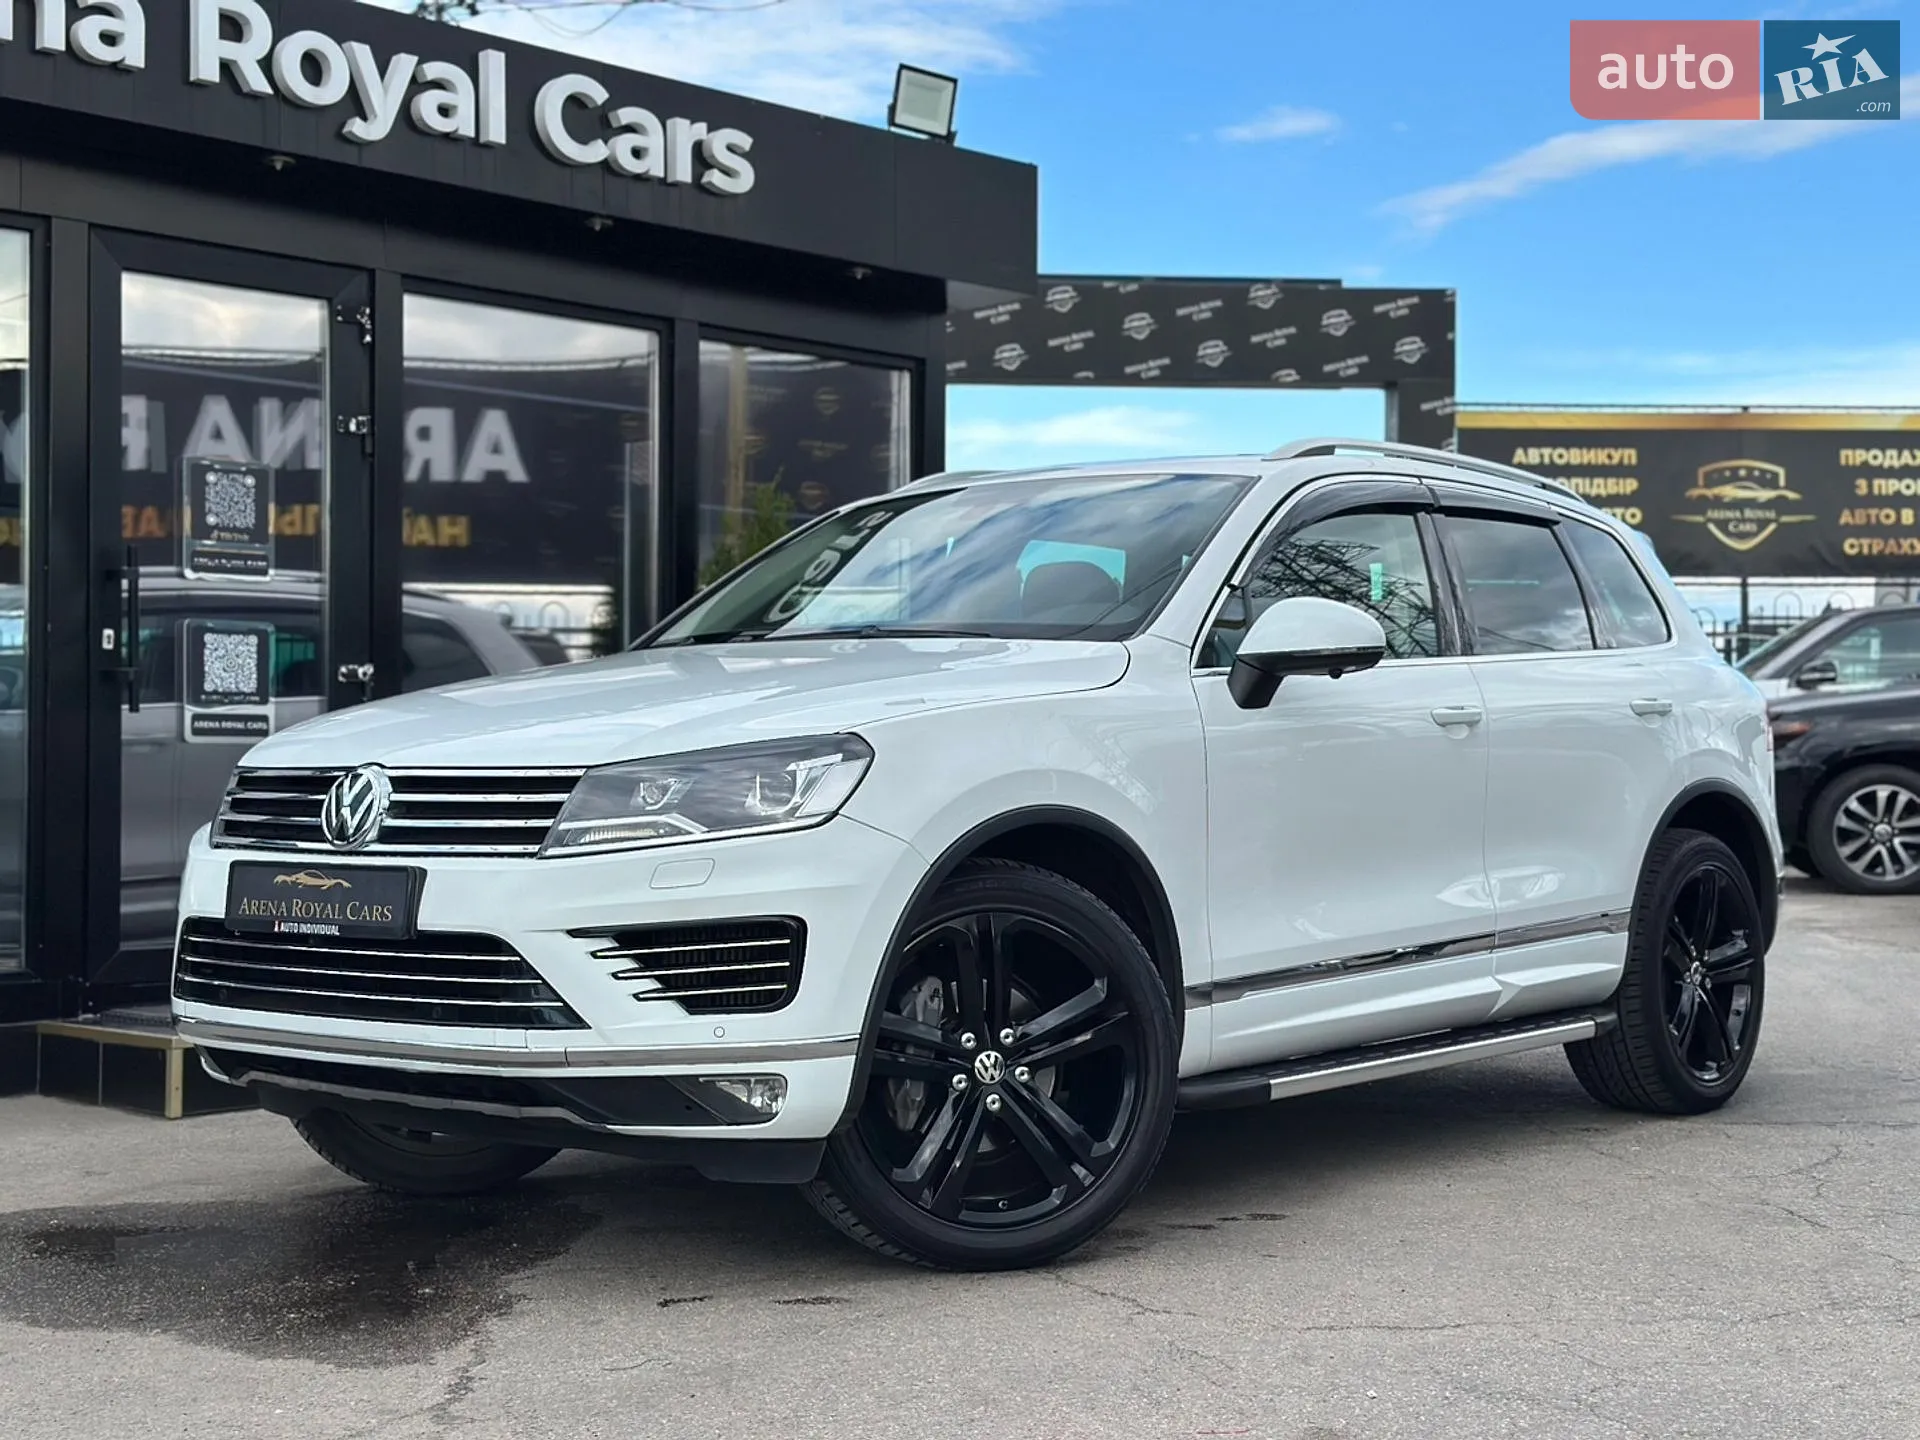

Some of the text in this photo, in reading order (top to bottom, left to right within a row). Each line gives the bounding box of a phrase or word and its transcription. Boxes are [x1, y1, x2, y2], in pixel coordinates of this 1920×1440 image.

[189, 0, 506, 145] Royal
[534, 73, 756, 195] Cars
[1512, 447, 1638, 465] АВТОВИКУП
[1872, 478, 1920, 496] ПРО
[1839, 507, 1915, 526] АВТО В
[280, 921, 299, 933] AUTO
